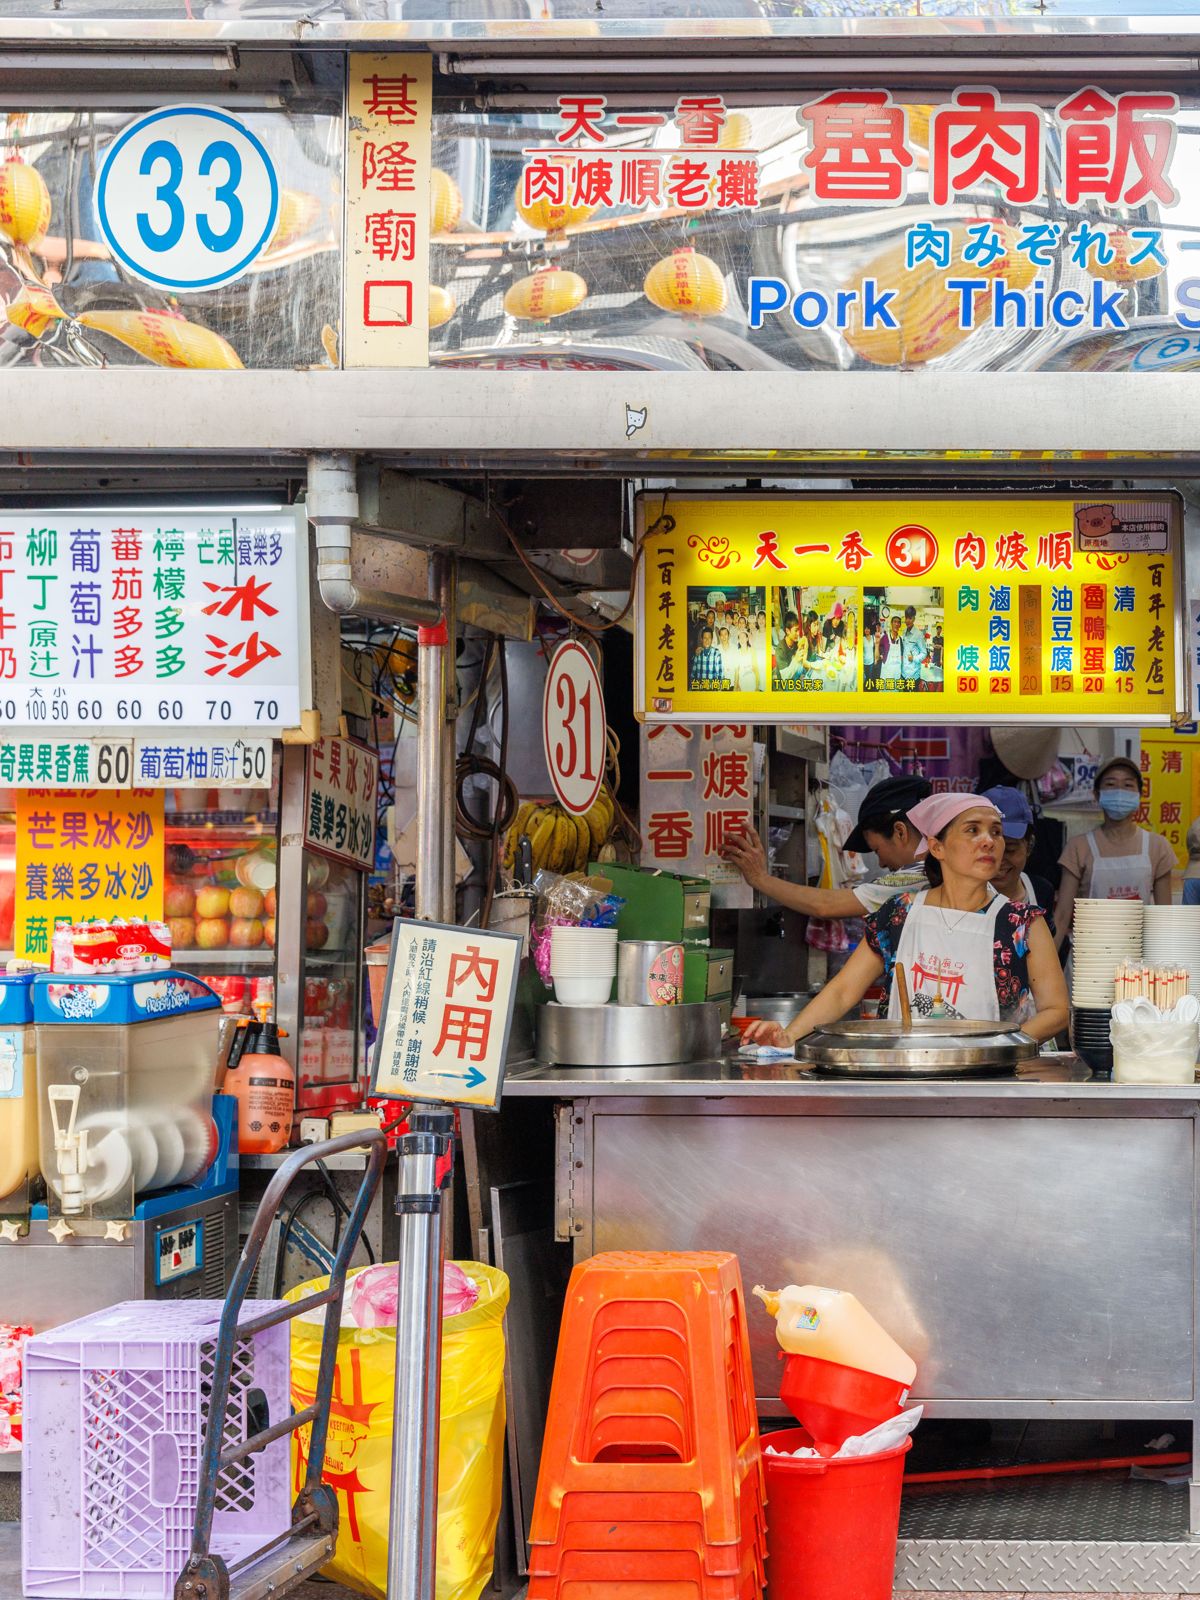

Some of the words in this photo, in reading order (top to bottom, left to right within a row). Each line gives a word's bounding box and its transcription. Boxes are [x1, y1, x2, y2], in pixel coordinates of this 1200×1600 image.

[556, 95, 727, 145] 天一香
[136, 139, 245, 254] 33
[362, 73, 418, 328] 基隆廟口
[523, 157, 759, 209] 肉焿順老攤
[750, 279, 896, 329] Pork
[950, 279, 1125, 329] Thick
[197, 529, 234, 566] 芒果
[238, 529, 283, 566] 養樂多
[752, 529, 873, 571] 天一香
[894, 536, 930, 568] 31
[955, 531, 1075, 572] 肉焿順
[69, 528, 103, 679] 葡萄汁
[111, 528, 144, 678] 蕃茄多多
[153, 528, 186, 678] 檸檬多多
[200, 575, 283, 678] 冰沙
[988, 585, 1011, 673] 滷肉飯
[1051, 585, 1074, 673] 油豆腐
[1083, 585, 1106, 673] 魯鴨蛋
[29, 687, 43, 698] 大
[53, 687, 66, 698] 小
[773, 678, 824, 691] TVBS玩家
[959, 677, 978, 692] 50
[990, 677, 1010, 692] 25
[1022, 675, 1038, 691] 20
[1054, 676, 1072, 691] 15
[1084, 677, 1103, 692] 20
[1115, 677, 1134, 692] 15
[26, 701, 47, 720] 100
[52, 701, 69, 720] 50
[77, 701, 103, 720] 60
[117, 701, 142, 720] 60
[158, 701, 183, 720] 60
[206, 701, 232, 720] 70
[254, 701, 279, 720] 70
[556, 672, 597, 783] 31
[0, 744, 90, 784] 奇異果香蕉
[98, 744, 130, 784] 60
[243, 747, 266, 780] 50
[27, 811, 154, 851] 芒果冰沙
[25, 862, 153, 901] 養樂多冰沙
[432, 945, 500, 1062] 內用
